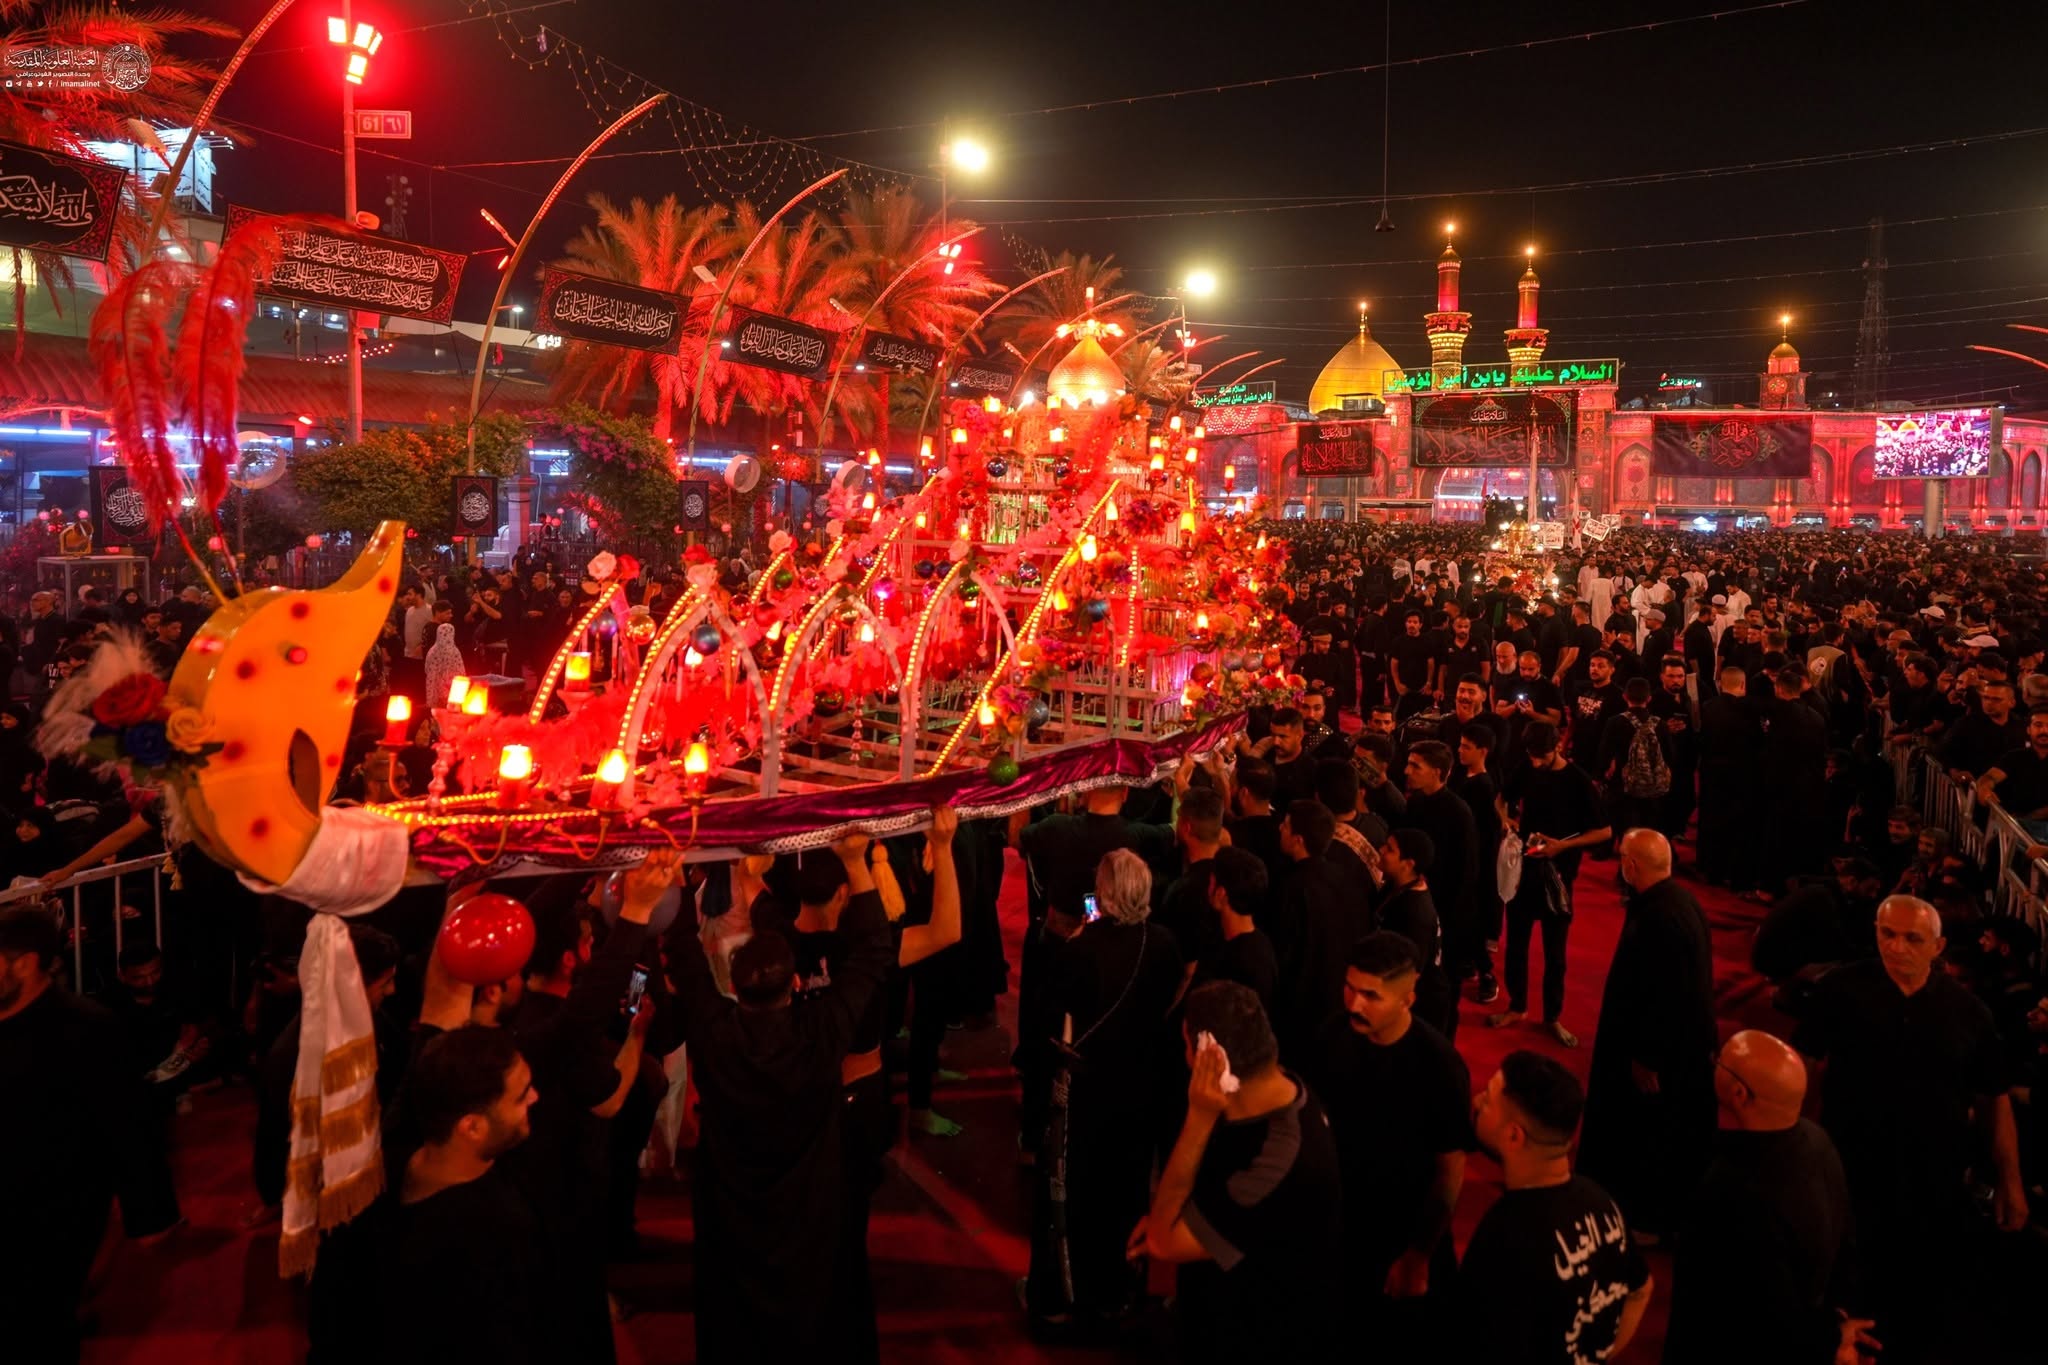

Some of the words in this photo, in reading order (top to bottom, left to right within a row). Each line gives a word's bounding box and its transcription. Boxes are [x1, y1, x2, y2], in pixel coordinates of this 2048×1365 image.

[362, 116, 378, 132] 61
[386, 117, 402, 132] ٦١
[354, 248, 396, 273] الحسين
[401, 255, 439, 282] السلام
[348, 278, 392, 300] الحسين
[554, 284, 594, 322] الزمان
[791, 336, 825, 366] السلام
[1387, 370, 1438, 391] المؤمنين
[1438, 366, 1468, 389] أمير
[1512, 366, 1555, 385] عليك
[1558, 363, 1613, 384] السلام
